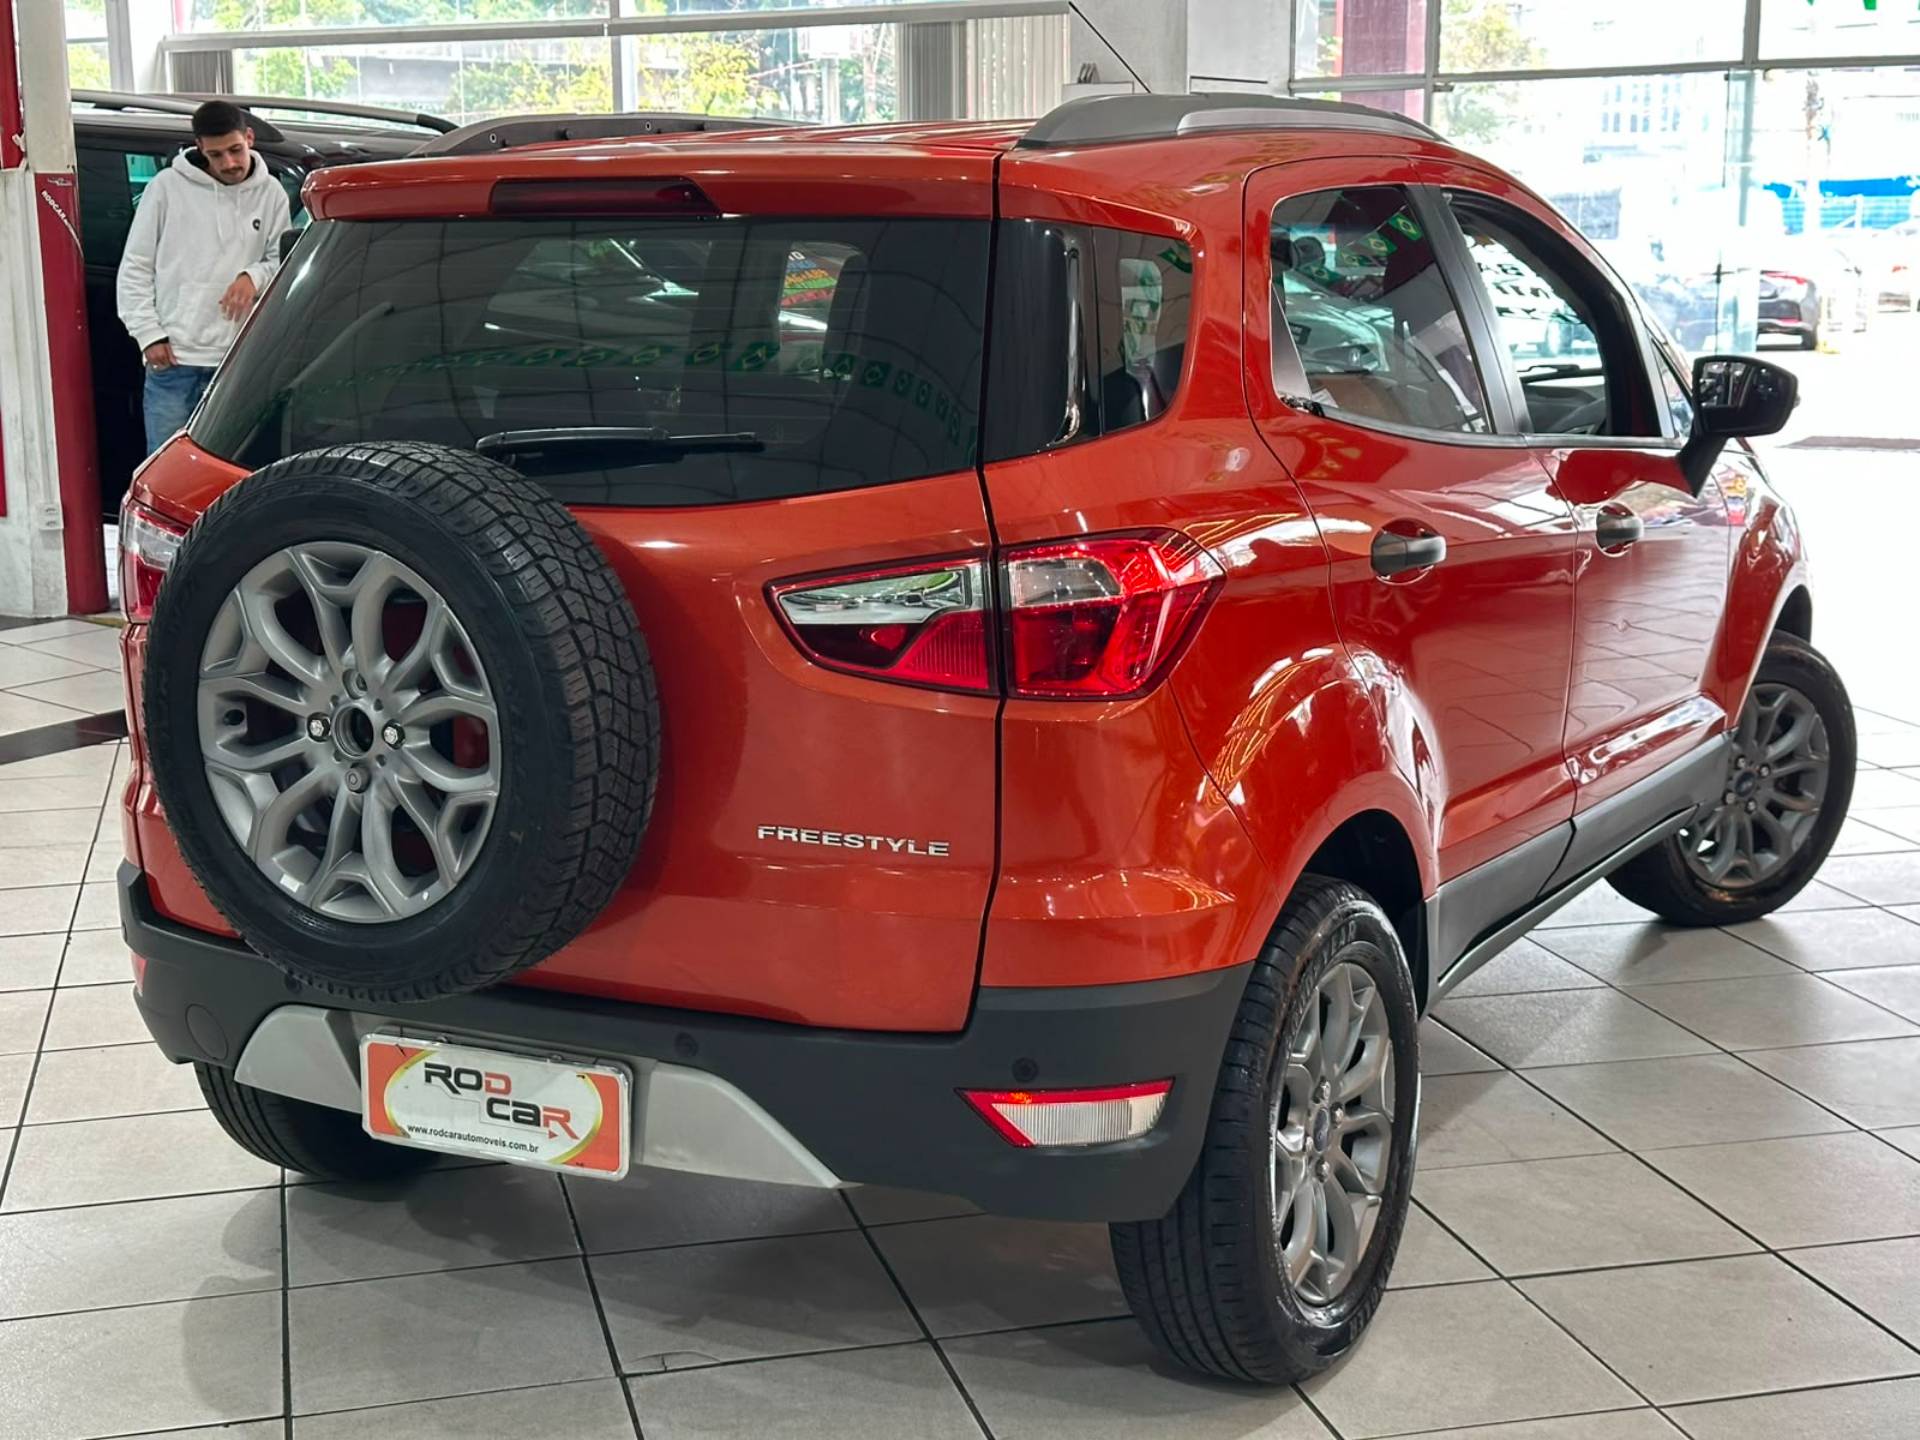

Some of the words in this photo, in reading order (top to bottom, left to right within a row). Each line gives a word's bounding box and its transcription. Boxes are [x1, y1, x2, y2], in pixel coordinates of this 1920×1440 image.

[42, 190, 66, 219] RODCAR
[757, 825, 950, 856] FREESTYLE
[407, 1124, 539, 1153] www.rodcarautomoveis.com.br
